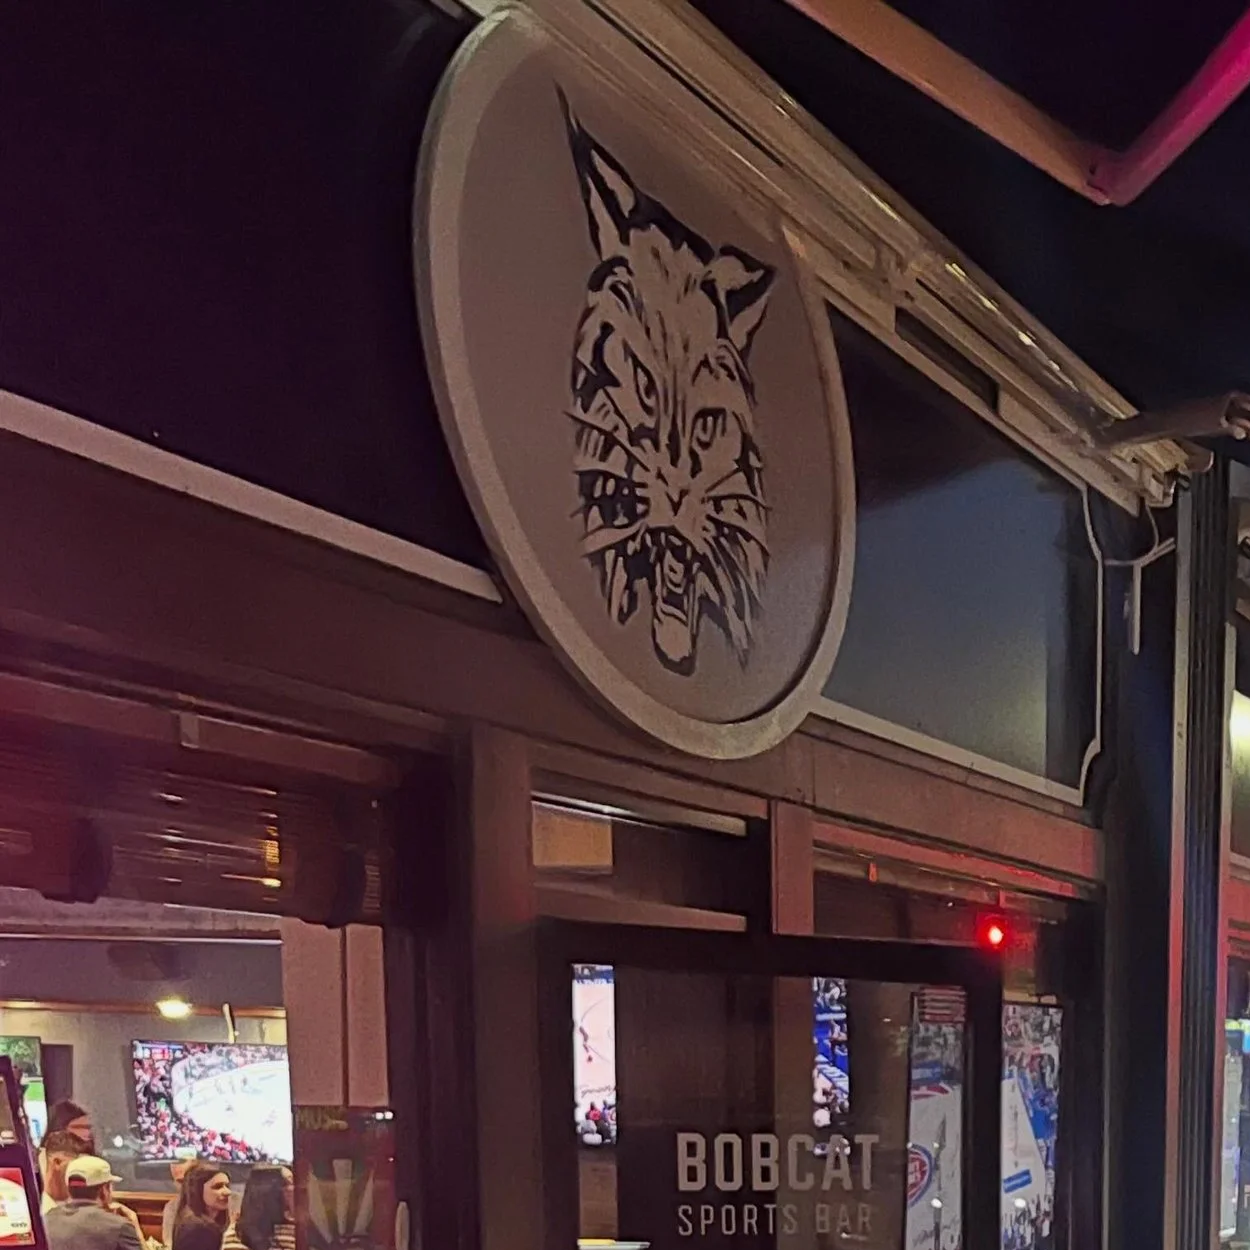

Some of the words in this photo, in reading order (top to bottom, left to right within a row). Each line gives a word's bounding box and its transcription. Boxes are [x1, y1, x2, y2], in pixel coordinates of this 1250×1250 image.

[677, 1132, 879, 1192] BOBCAT
[678, 1203, 798, 1236] SPORTS
[816, 1202, 872, 1234] BAR
